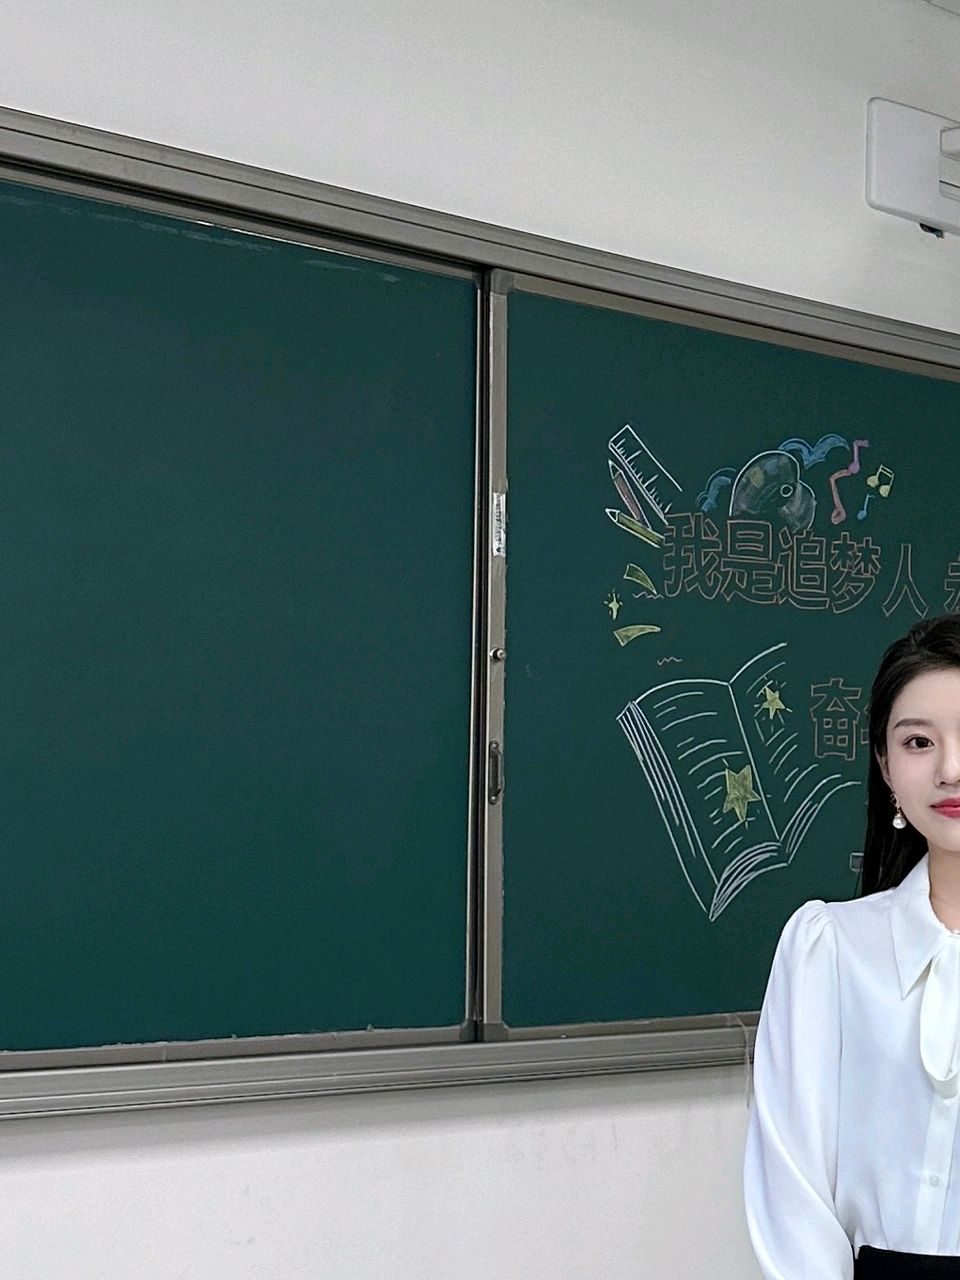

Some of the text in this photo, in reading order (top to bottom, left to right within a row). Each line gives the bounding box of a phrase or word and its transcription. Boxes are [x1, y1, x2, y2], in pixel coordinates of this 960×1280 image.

[663, 512, 930, 618] 我是追梦人
[809, 677, 870, 761] 奋
